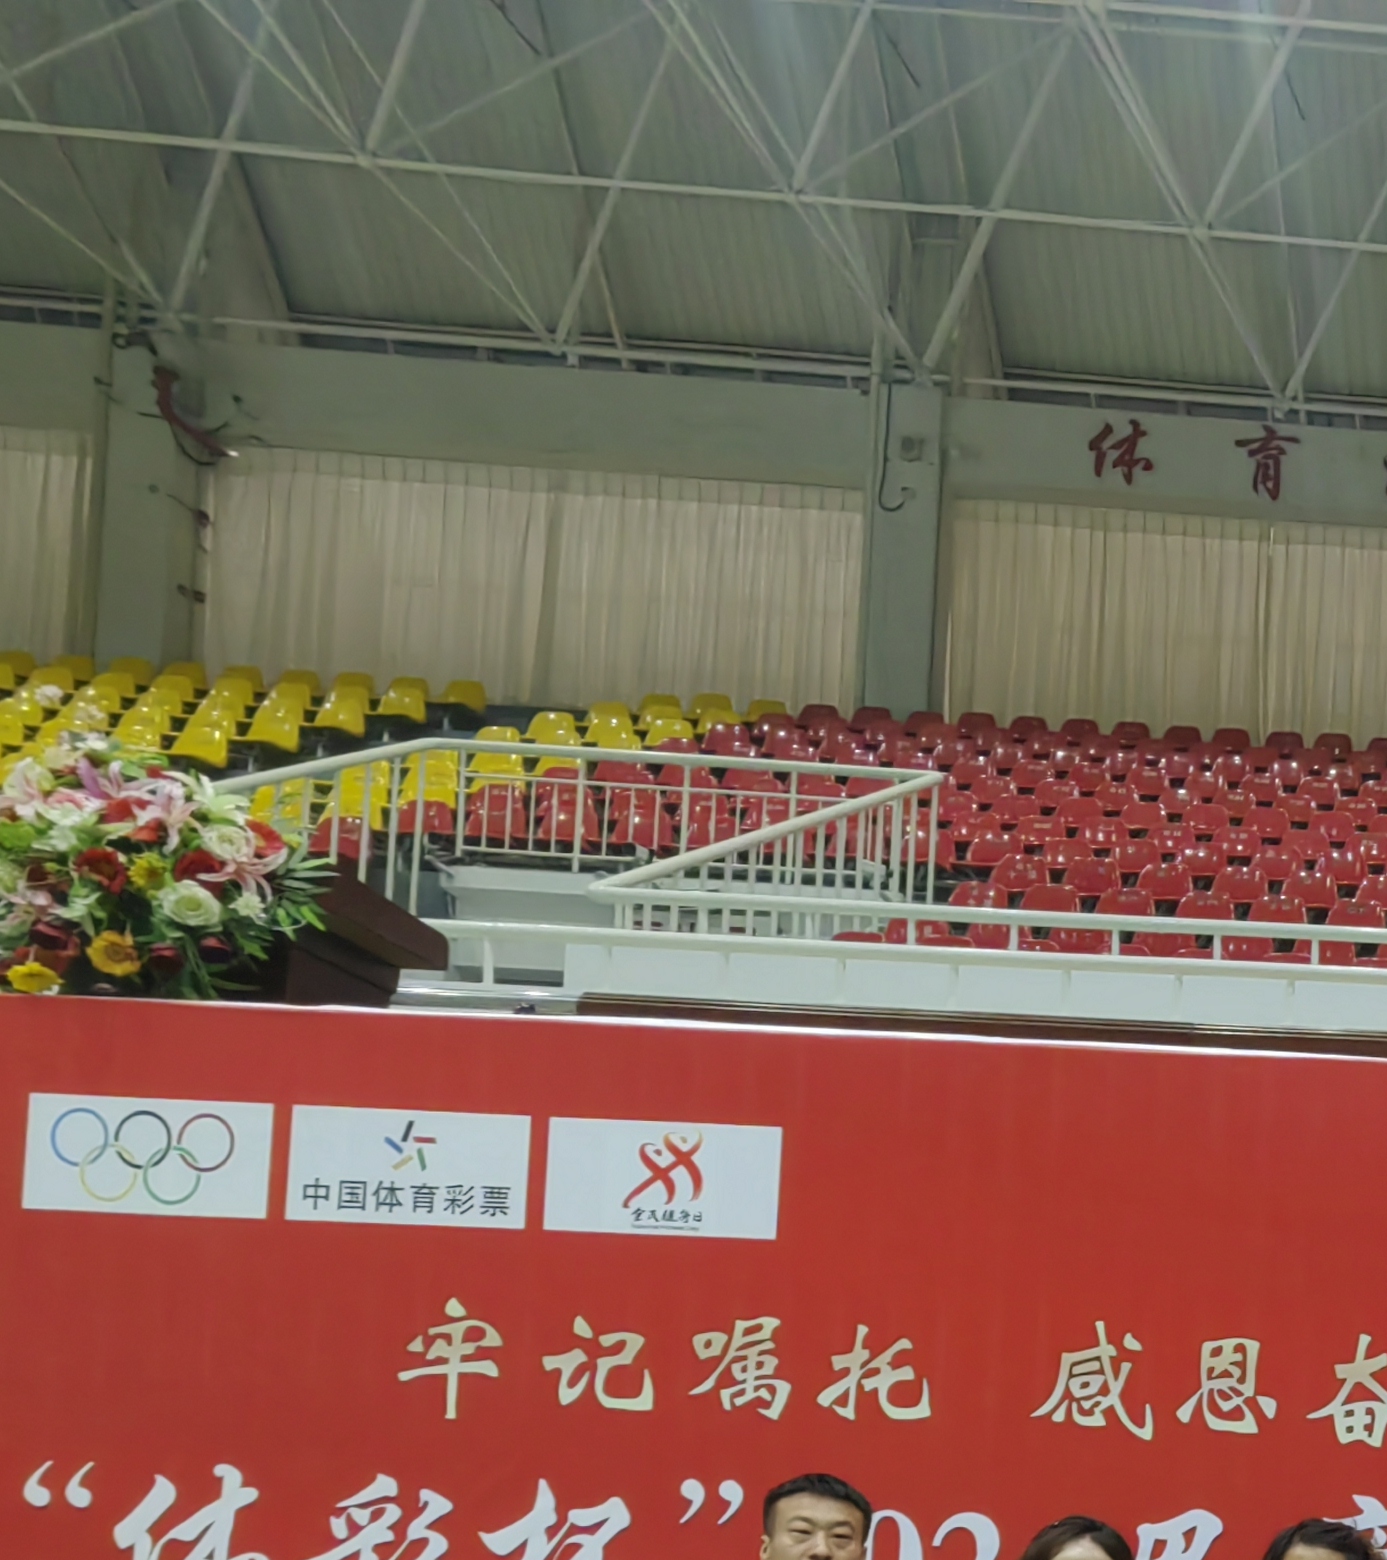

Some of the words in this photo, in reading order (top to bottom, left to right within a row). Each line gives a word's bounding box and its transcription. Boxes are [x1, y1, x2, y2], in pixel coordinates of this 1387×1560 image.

[301, 1178, 511, 1218] 中国体育彩票
[397, 1296, 932, 1422] 牢记嘱托
